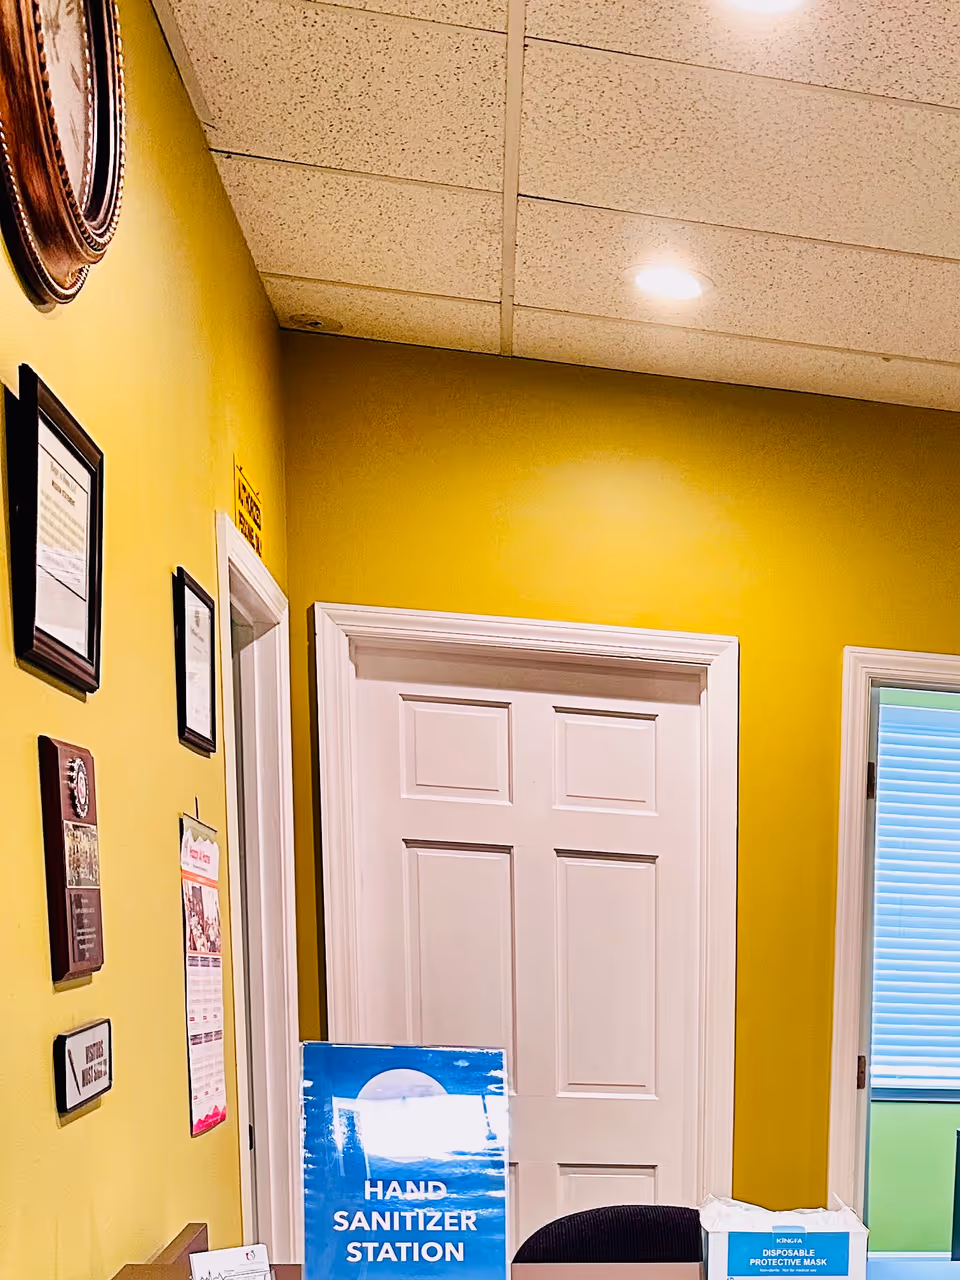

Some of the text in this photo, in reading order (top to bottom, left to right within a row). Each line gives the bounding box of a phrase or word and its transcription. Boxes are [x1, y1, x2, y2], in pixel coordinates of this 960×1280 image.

[363, 1180, 448, 1200] HAND
[333, 1210, 478, 1231] SANITIZER
[346, 1241, 465, 1263] STATION
[749, 1258, 828, 1266] PROTECTIVE MASK
[762, 1249, 815, 1257] DISPOSABLE
